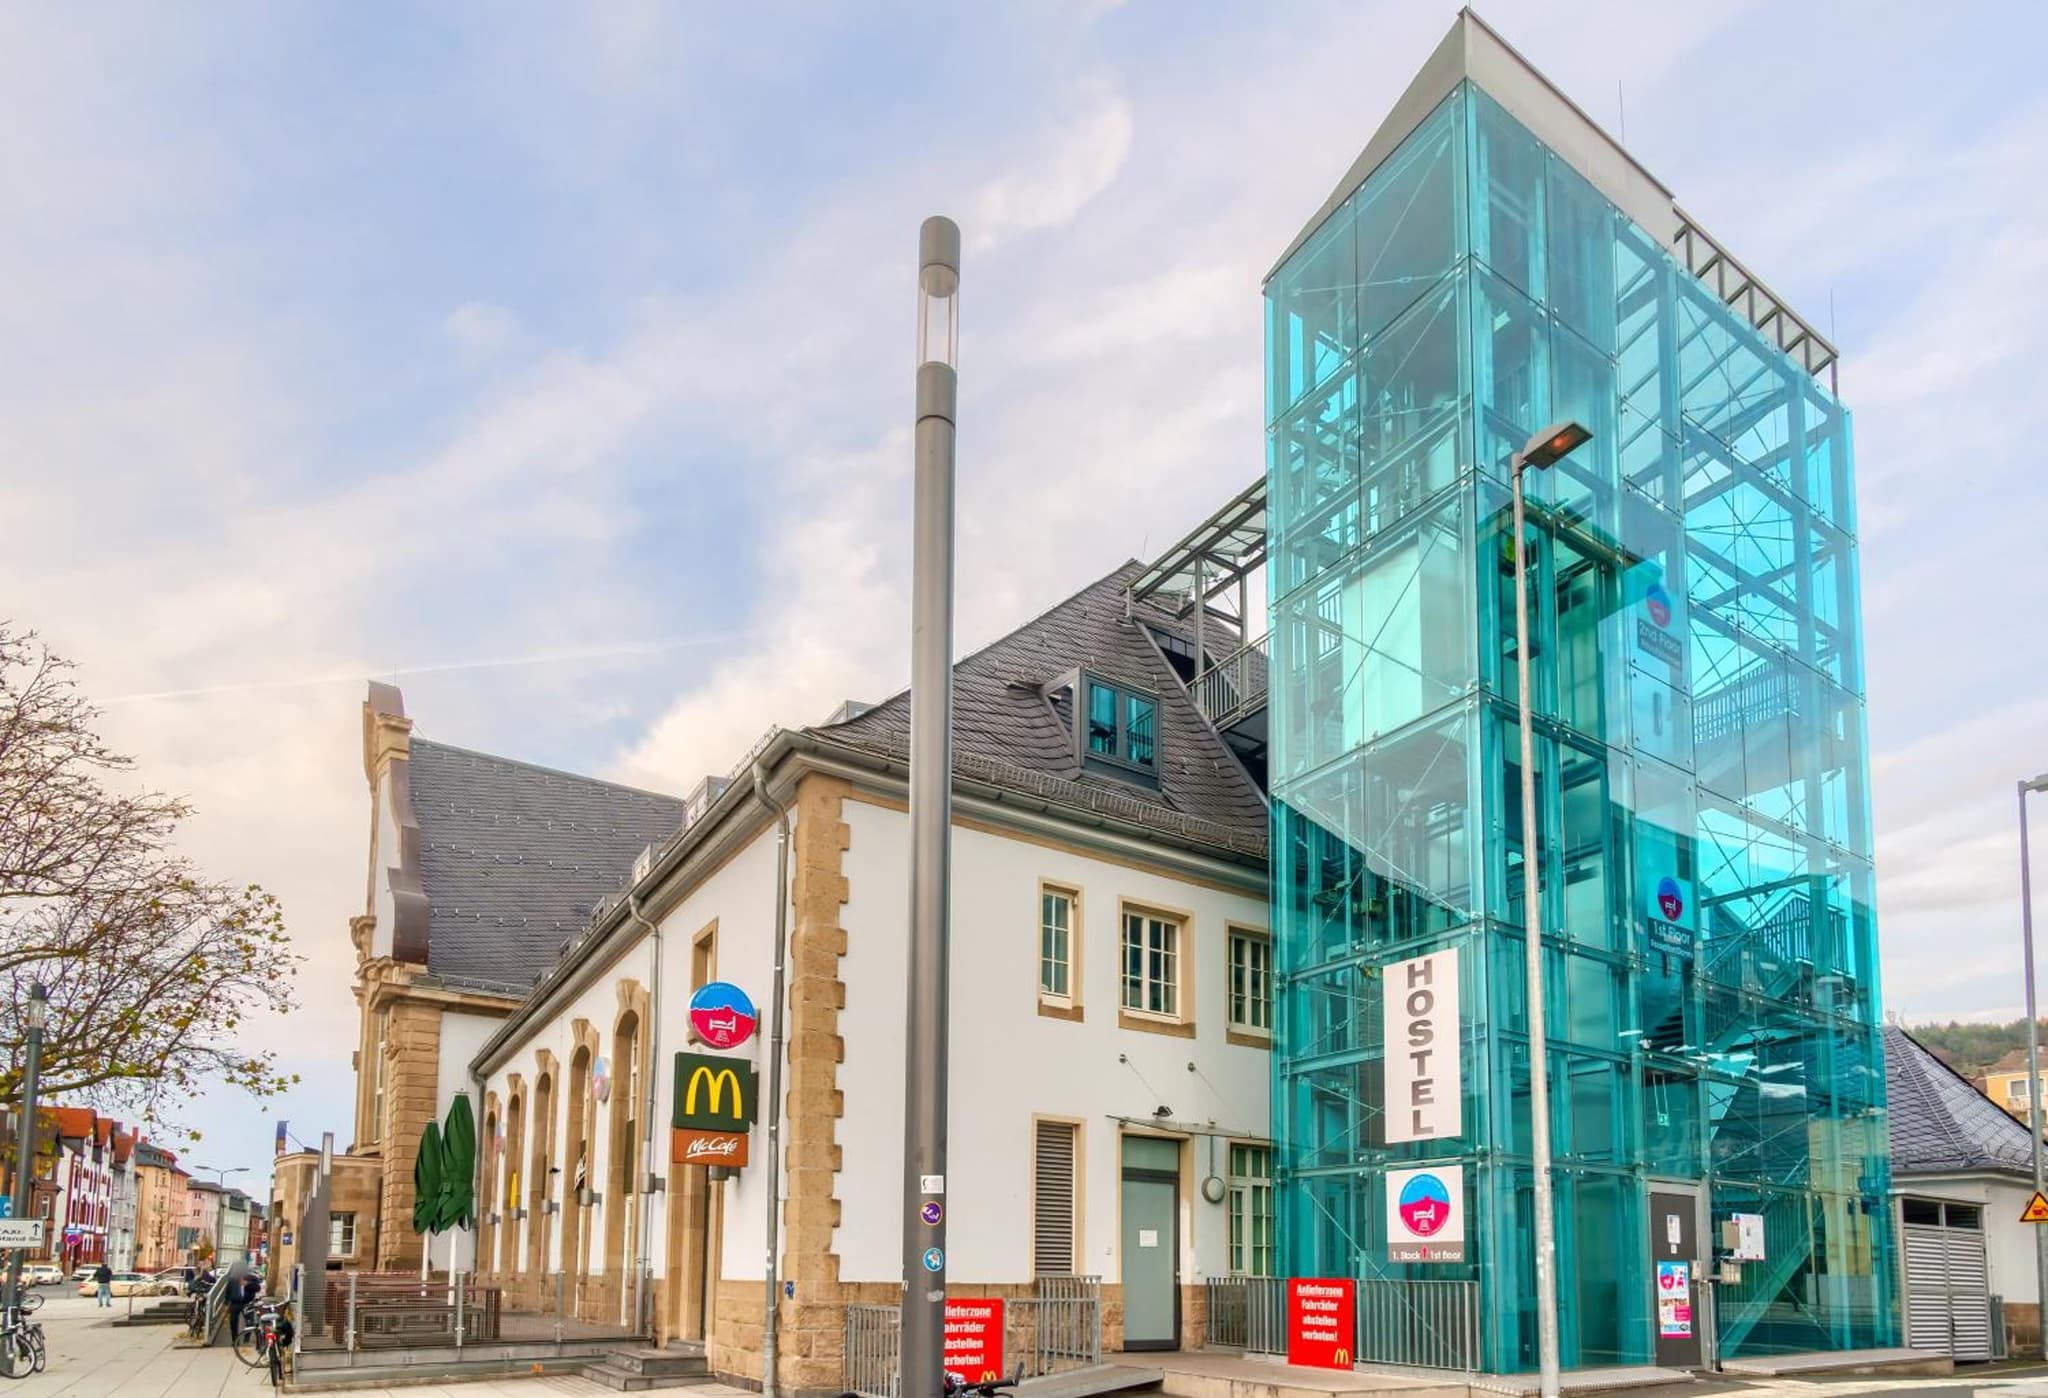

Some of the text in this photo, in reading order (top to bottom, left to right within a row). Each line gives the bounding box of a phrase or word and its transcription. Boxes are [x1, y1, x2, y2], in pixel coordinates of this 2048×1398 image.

[1407, 959, 1434, 1136] HOSTEL
[685, 1066, 742, 1119] M
[945, 1305, 992, 1318] lieferzone
[944, 1321, 985, 1333] ahrräder
[944, 1338, 984, 1349] bstellen
[944, 1353, 984, 1366] erboten!
